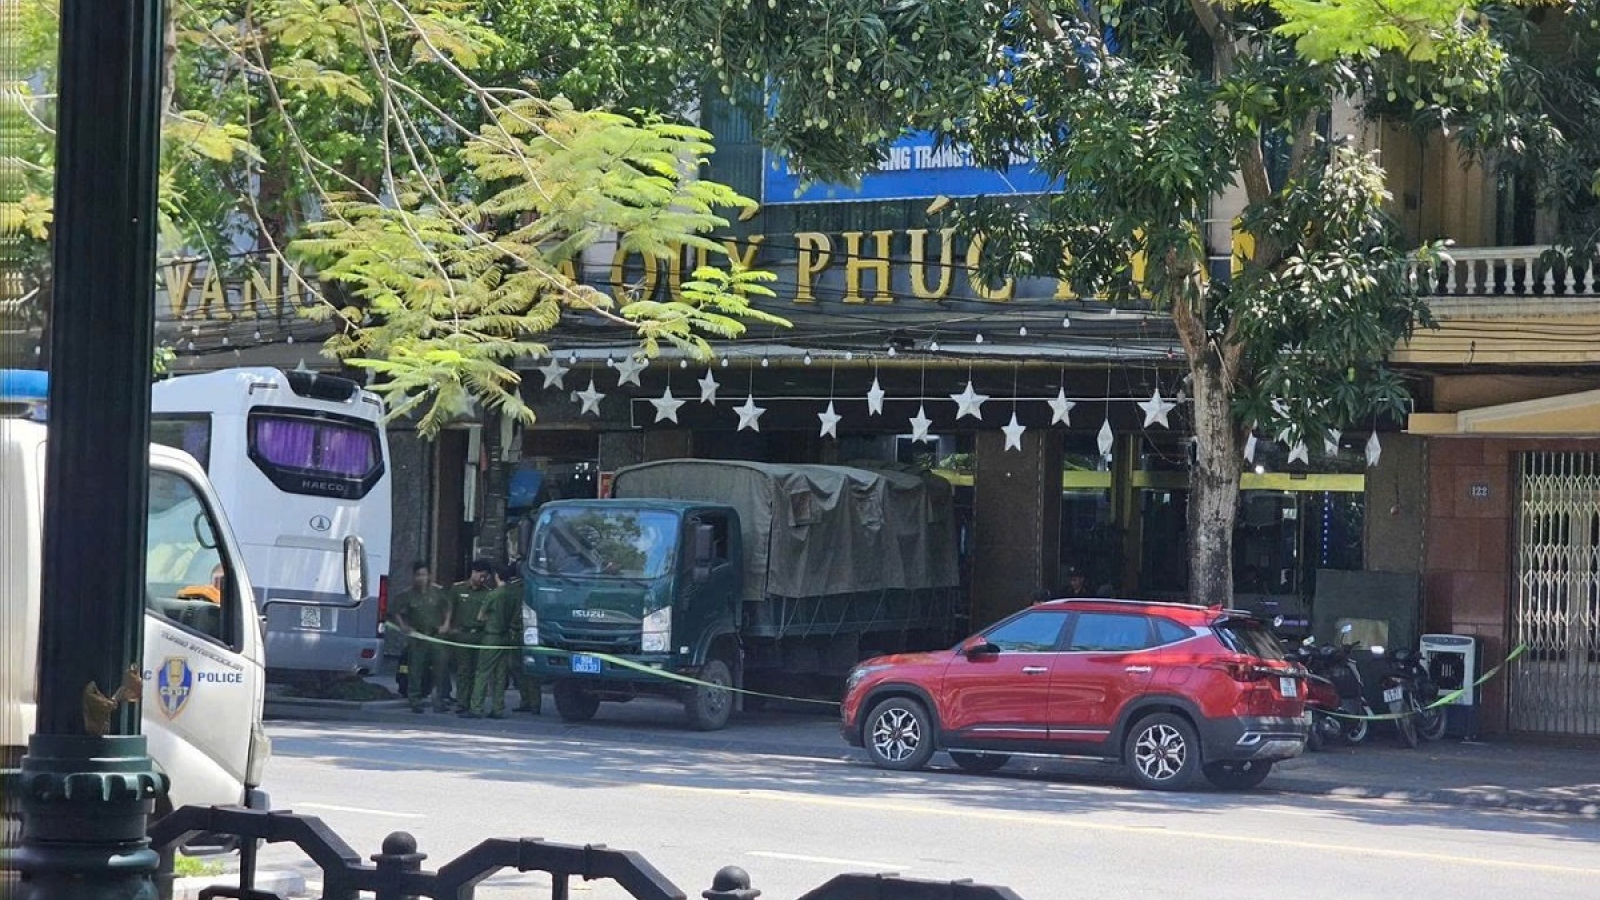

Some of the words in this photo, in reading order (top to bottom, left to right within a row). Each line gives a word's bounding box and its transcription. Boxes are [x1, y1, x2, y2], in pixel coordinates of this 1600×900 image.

[793, 194, 1019, 304] PHÚC
[301, 480, 345, 492] HAECO
[571, 609, 605, 619] ISUZU
[197, 672, 243, 683] POLICE
